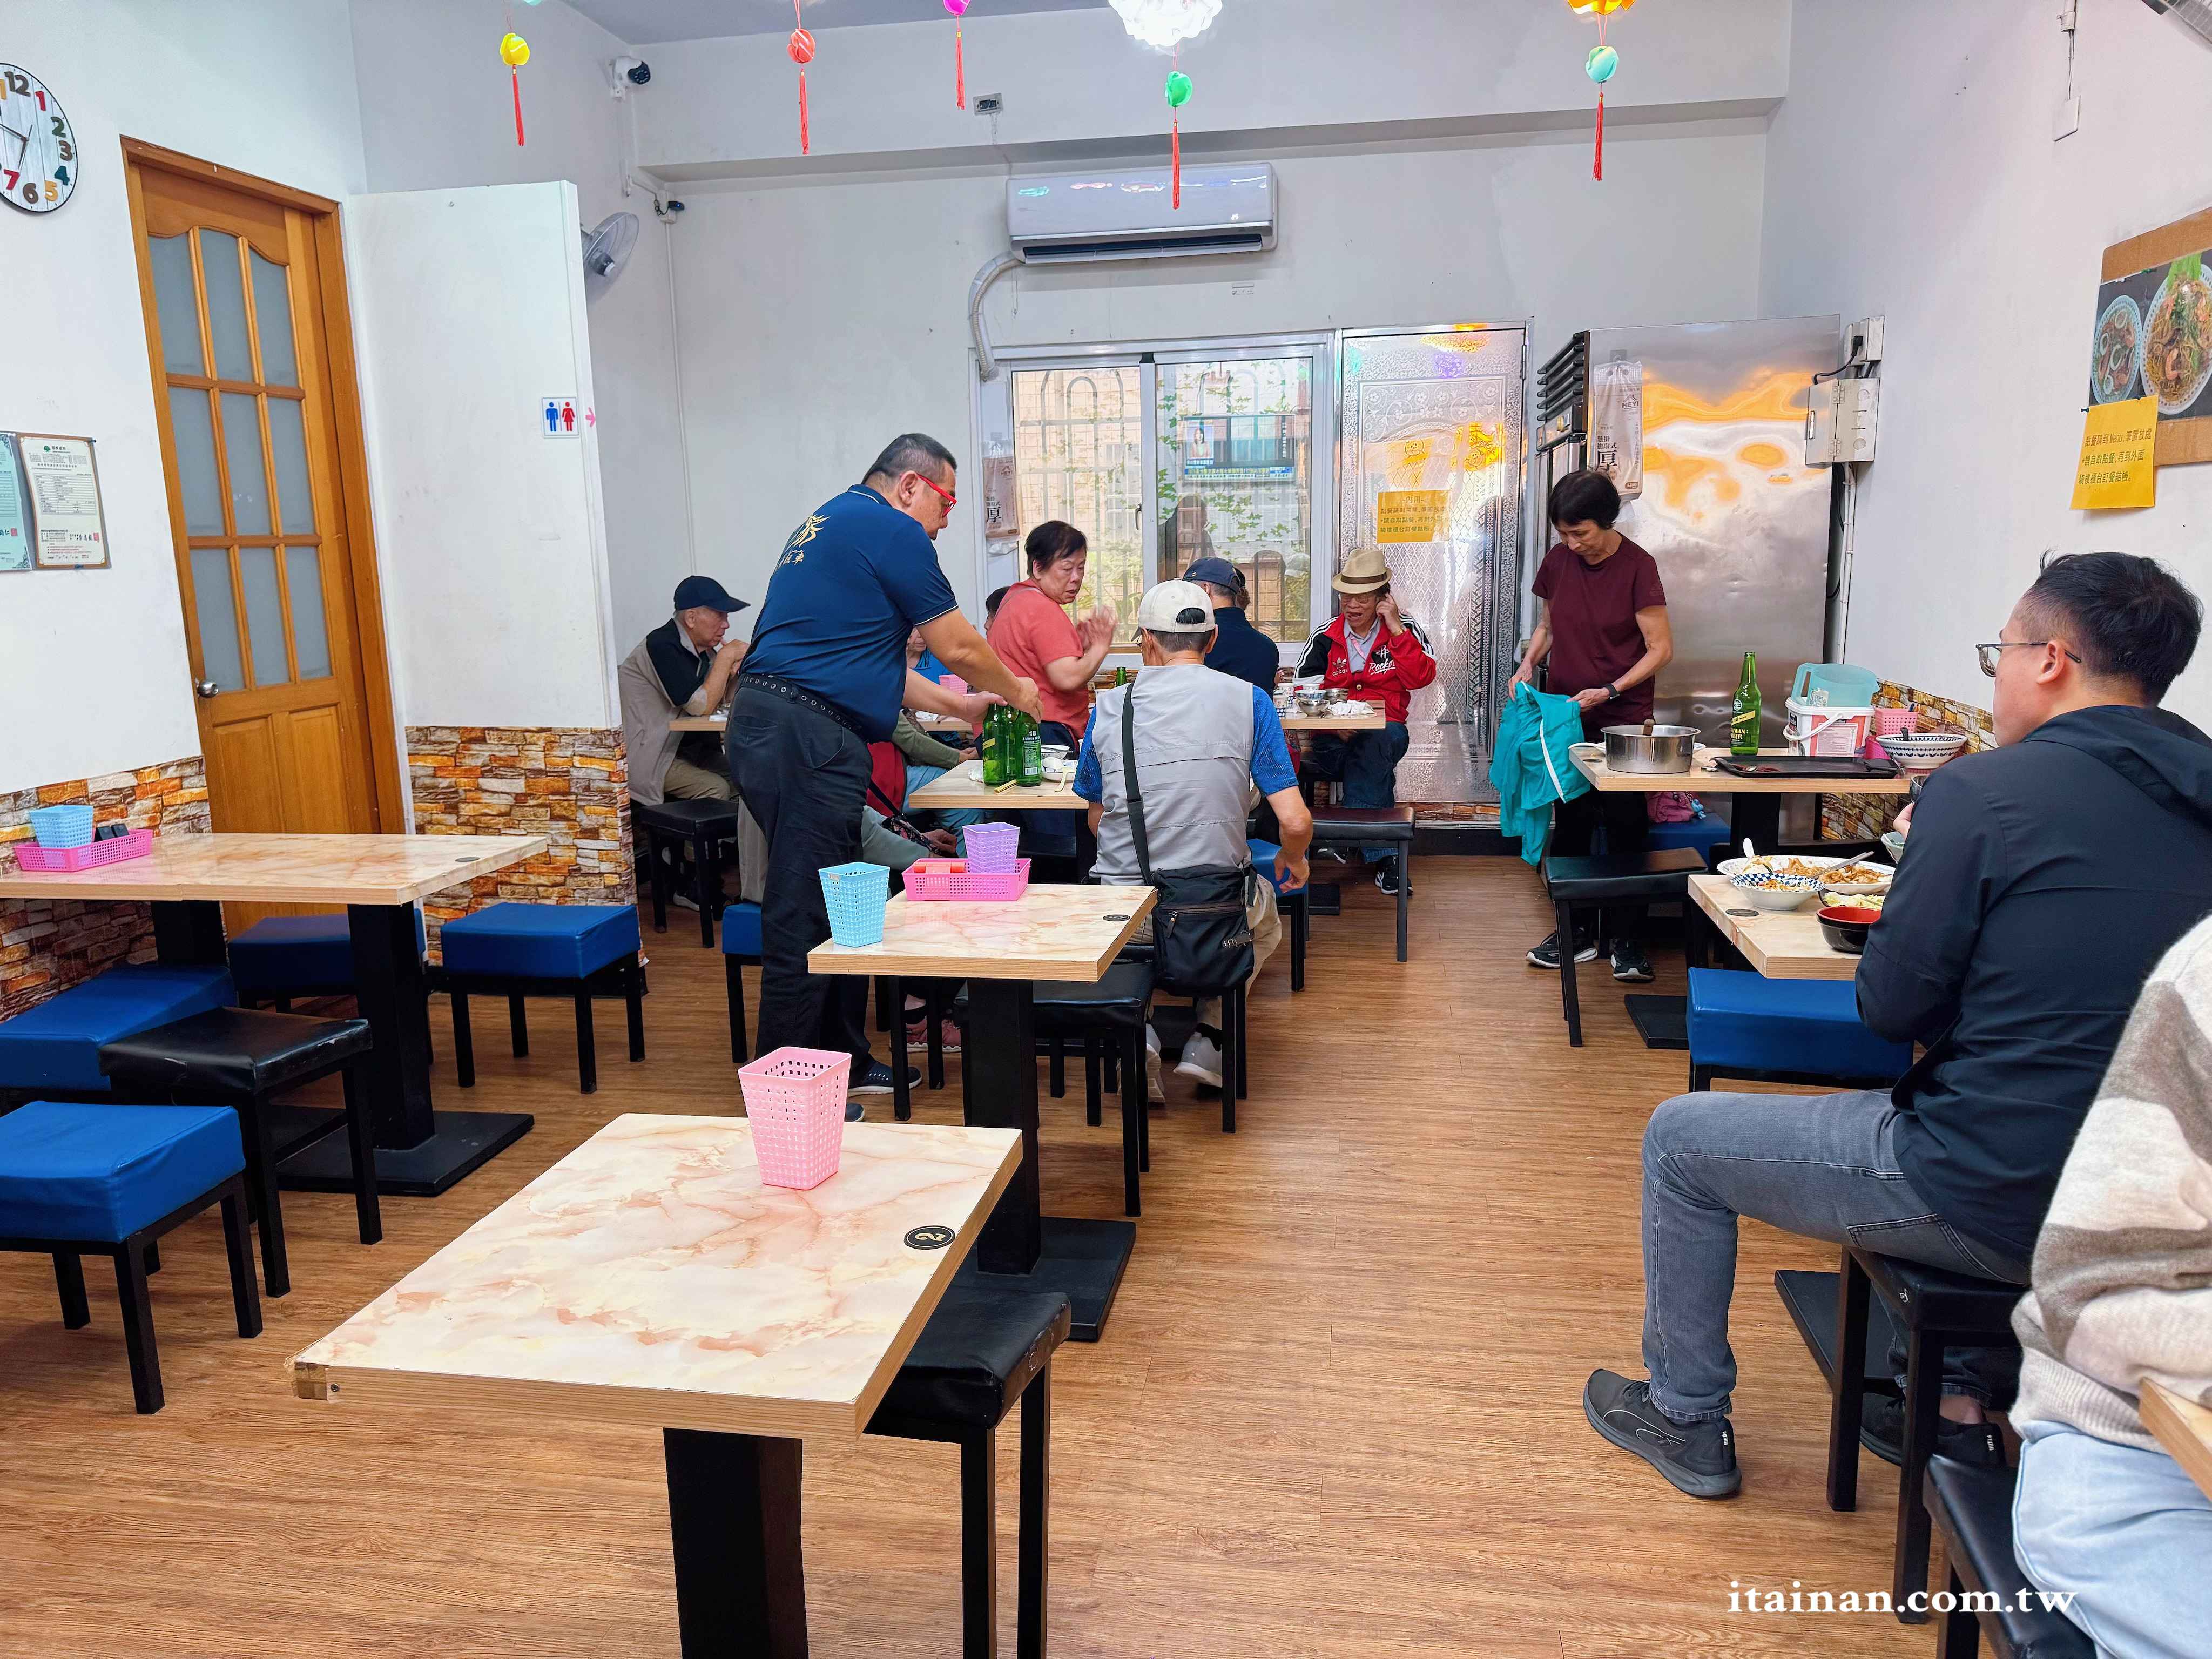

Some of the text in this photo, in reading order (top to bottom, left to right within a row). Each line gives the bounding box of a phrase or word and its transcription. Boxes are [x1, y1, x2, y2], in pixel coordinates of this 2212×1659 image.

[4, 71, 31, 97] 12
[35, 91, 46, 111] 1
[51, 116, 66, 138] 2
[58, 140, 73, 161] 3
[3, 168, 19, 190] 7
[55, 165, 70, 186] 4
[23, 183, 39, 204] 6
[45, 180, 58, 201] 5
[1595, 449, 1617, 471] 厚
[986, 507, 1001, 523] 厚
